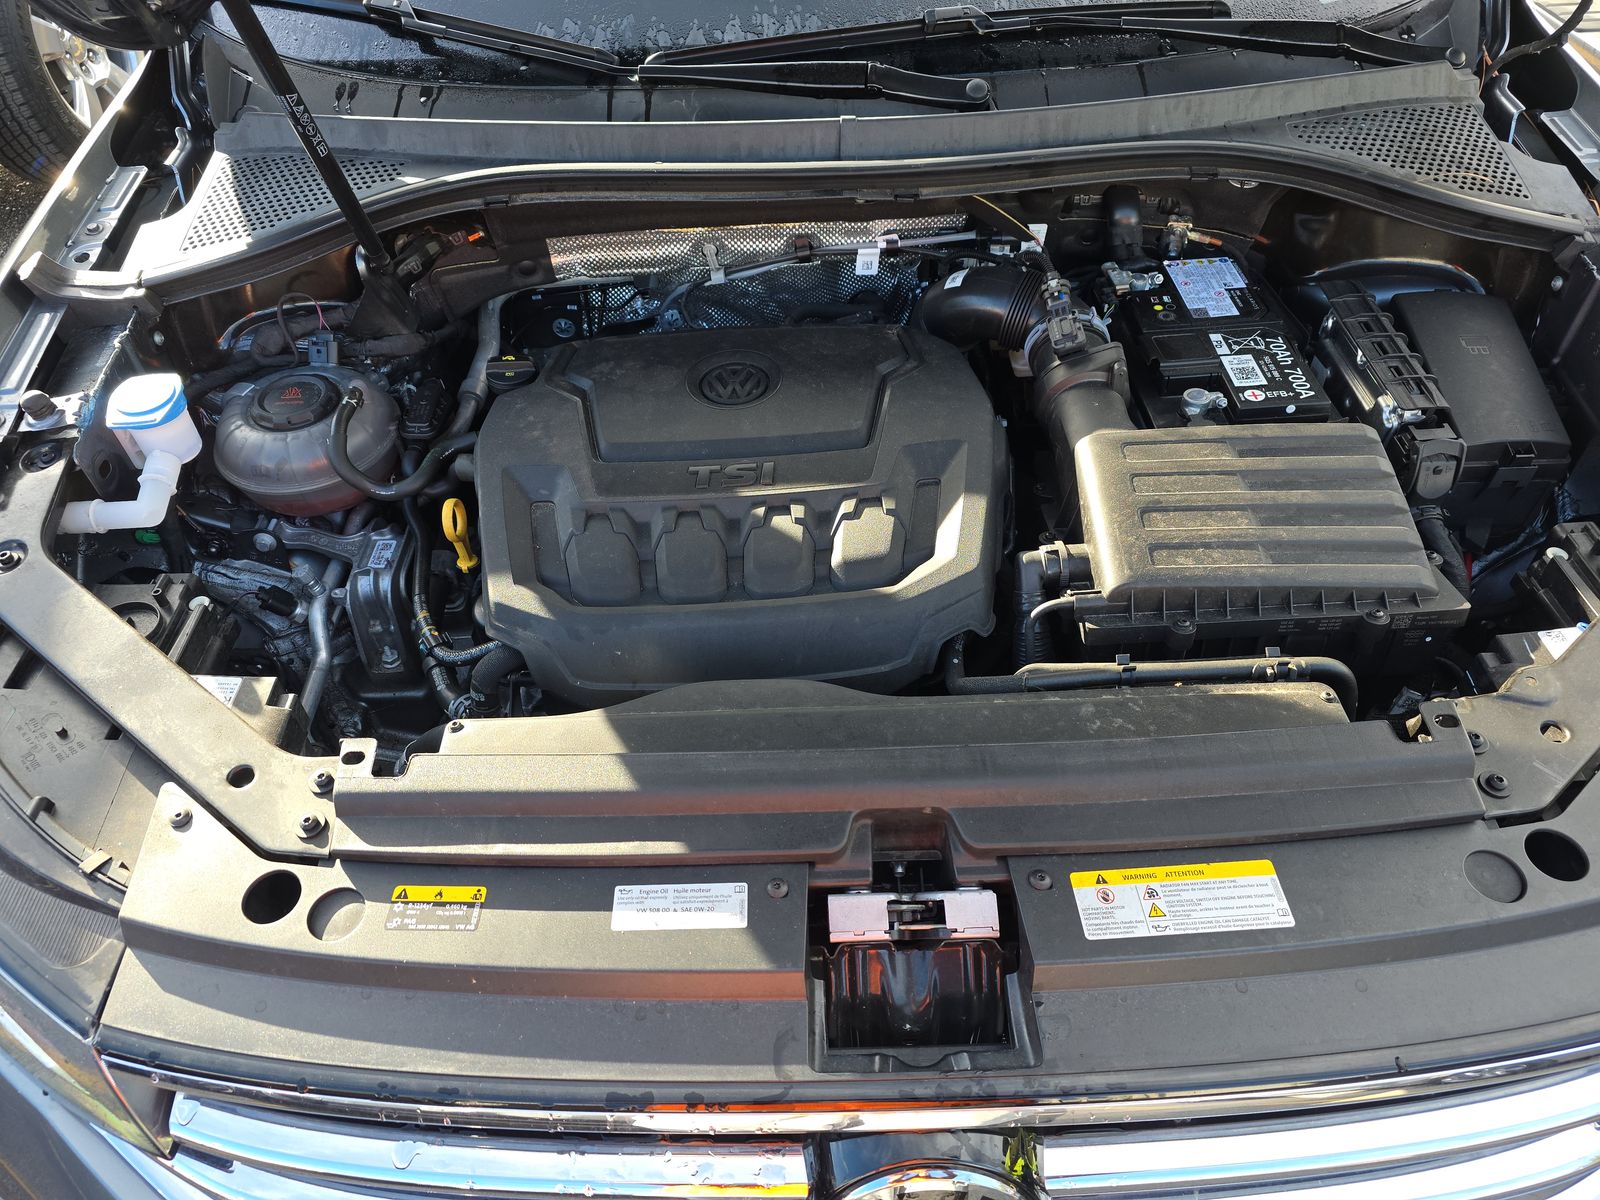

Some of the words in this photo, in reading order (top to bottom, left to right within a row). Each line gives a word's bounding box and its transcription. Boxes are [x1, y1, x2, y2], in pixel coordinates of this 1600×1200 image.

[1266, 337, 1294, 365] 70Ah
[1284, 368, 1315, 399] 700A
[687, 461, 775, 489] TSI
[1122, 872, 1157, 880] WARNING
[1165, 870, 1205, 878] ATTENTION
